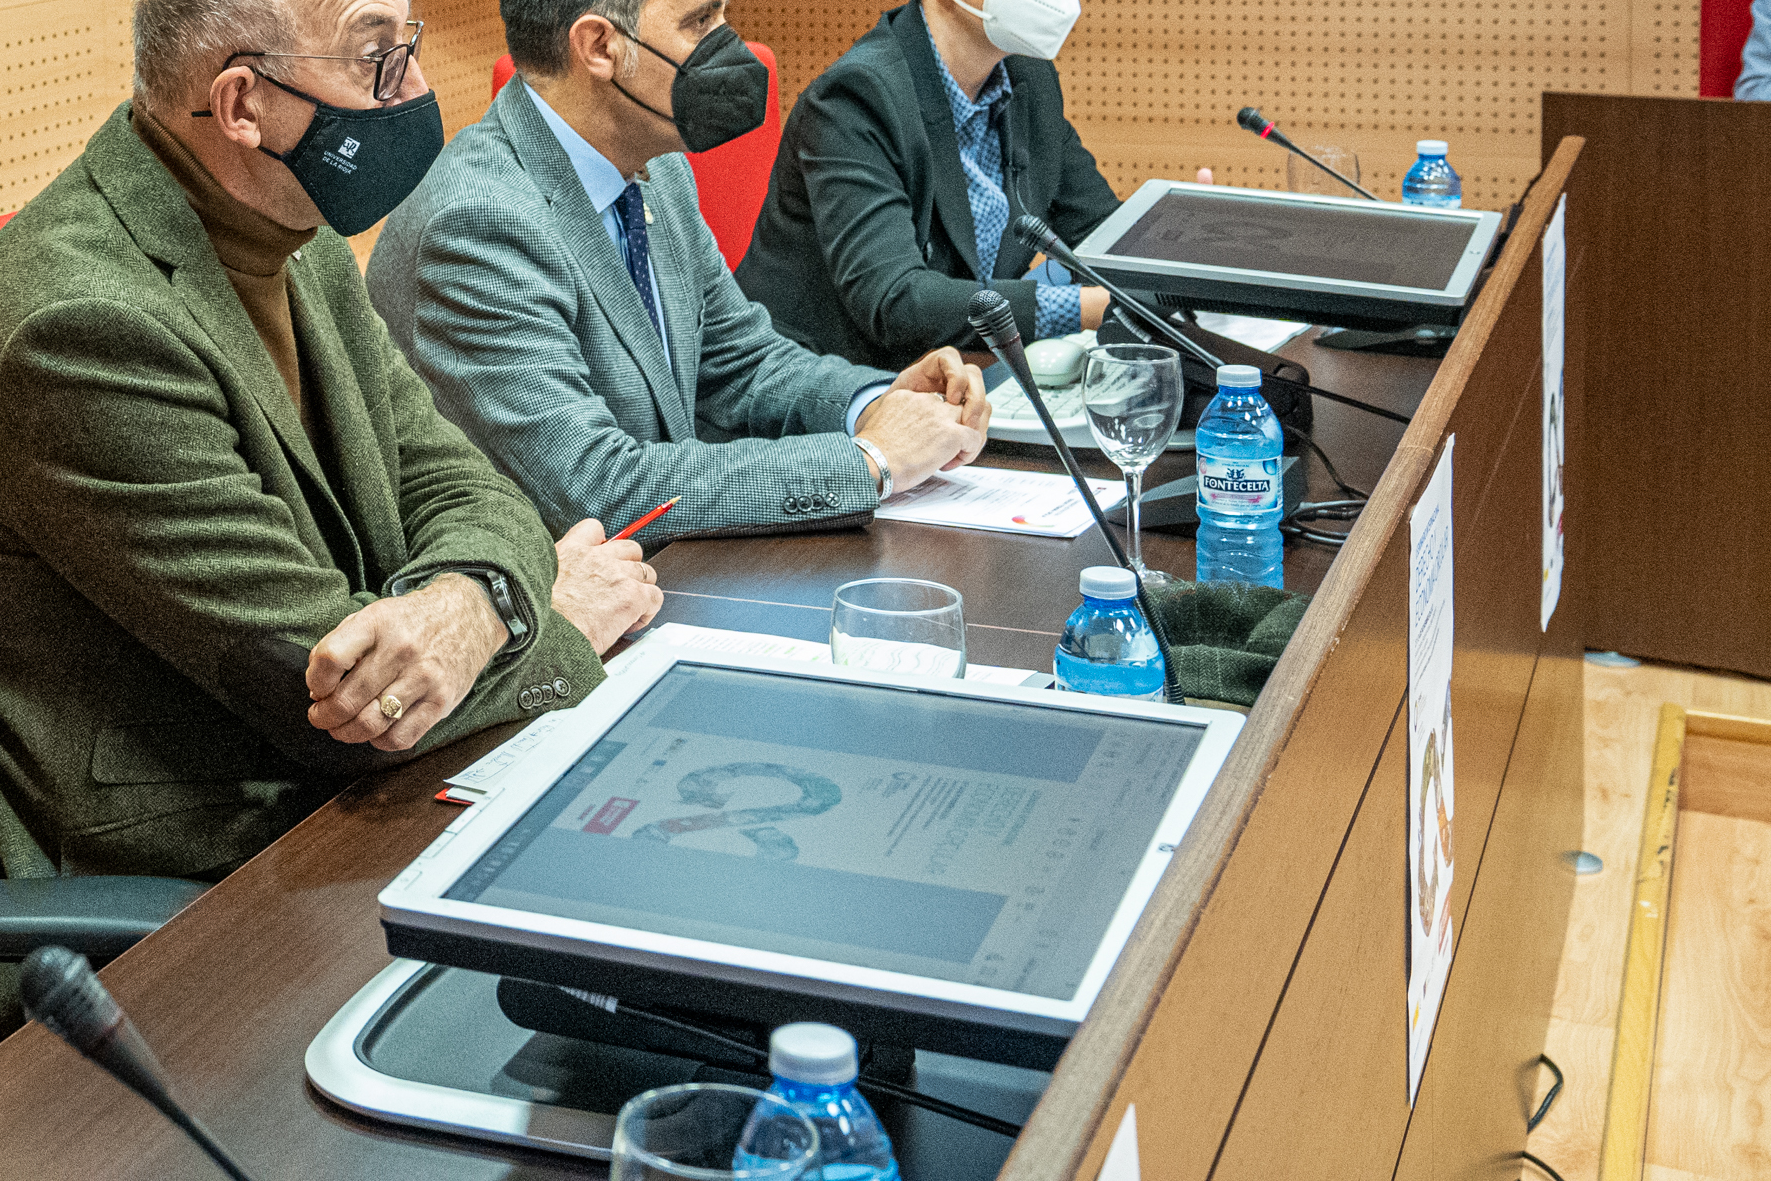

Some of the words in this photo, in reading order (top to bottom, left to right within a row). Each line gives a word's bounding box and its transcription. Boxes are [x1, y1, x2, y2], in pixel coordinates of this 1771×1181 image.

[324, 151, 357, 169] UNIVERSIDAD
[338, 164, 352, 174] RIOJA
[1205, 476, 1269, 491] FONTECELTA
